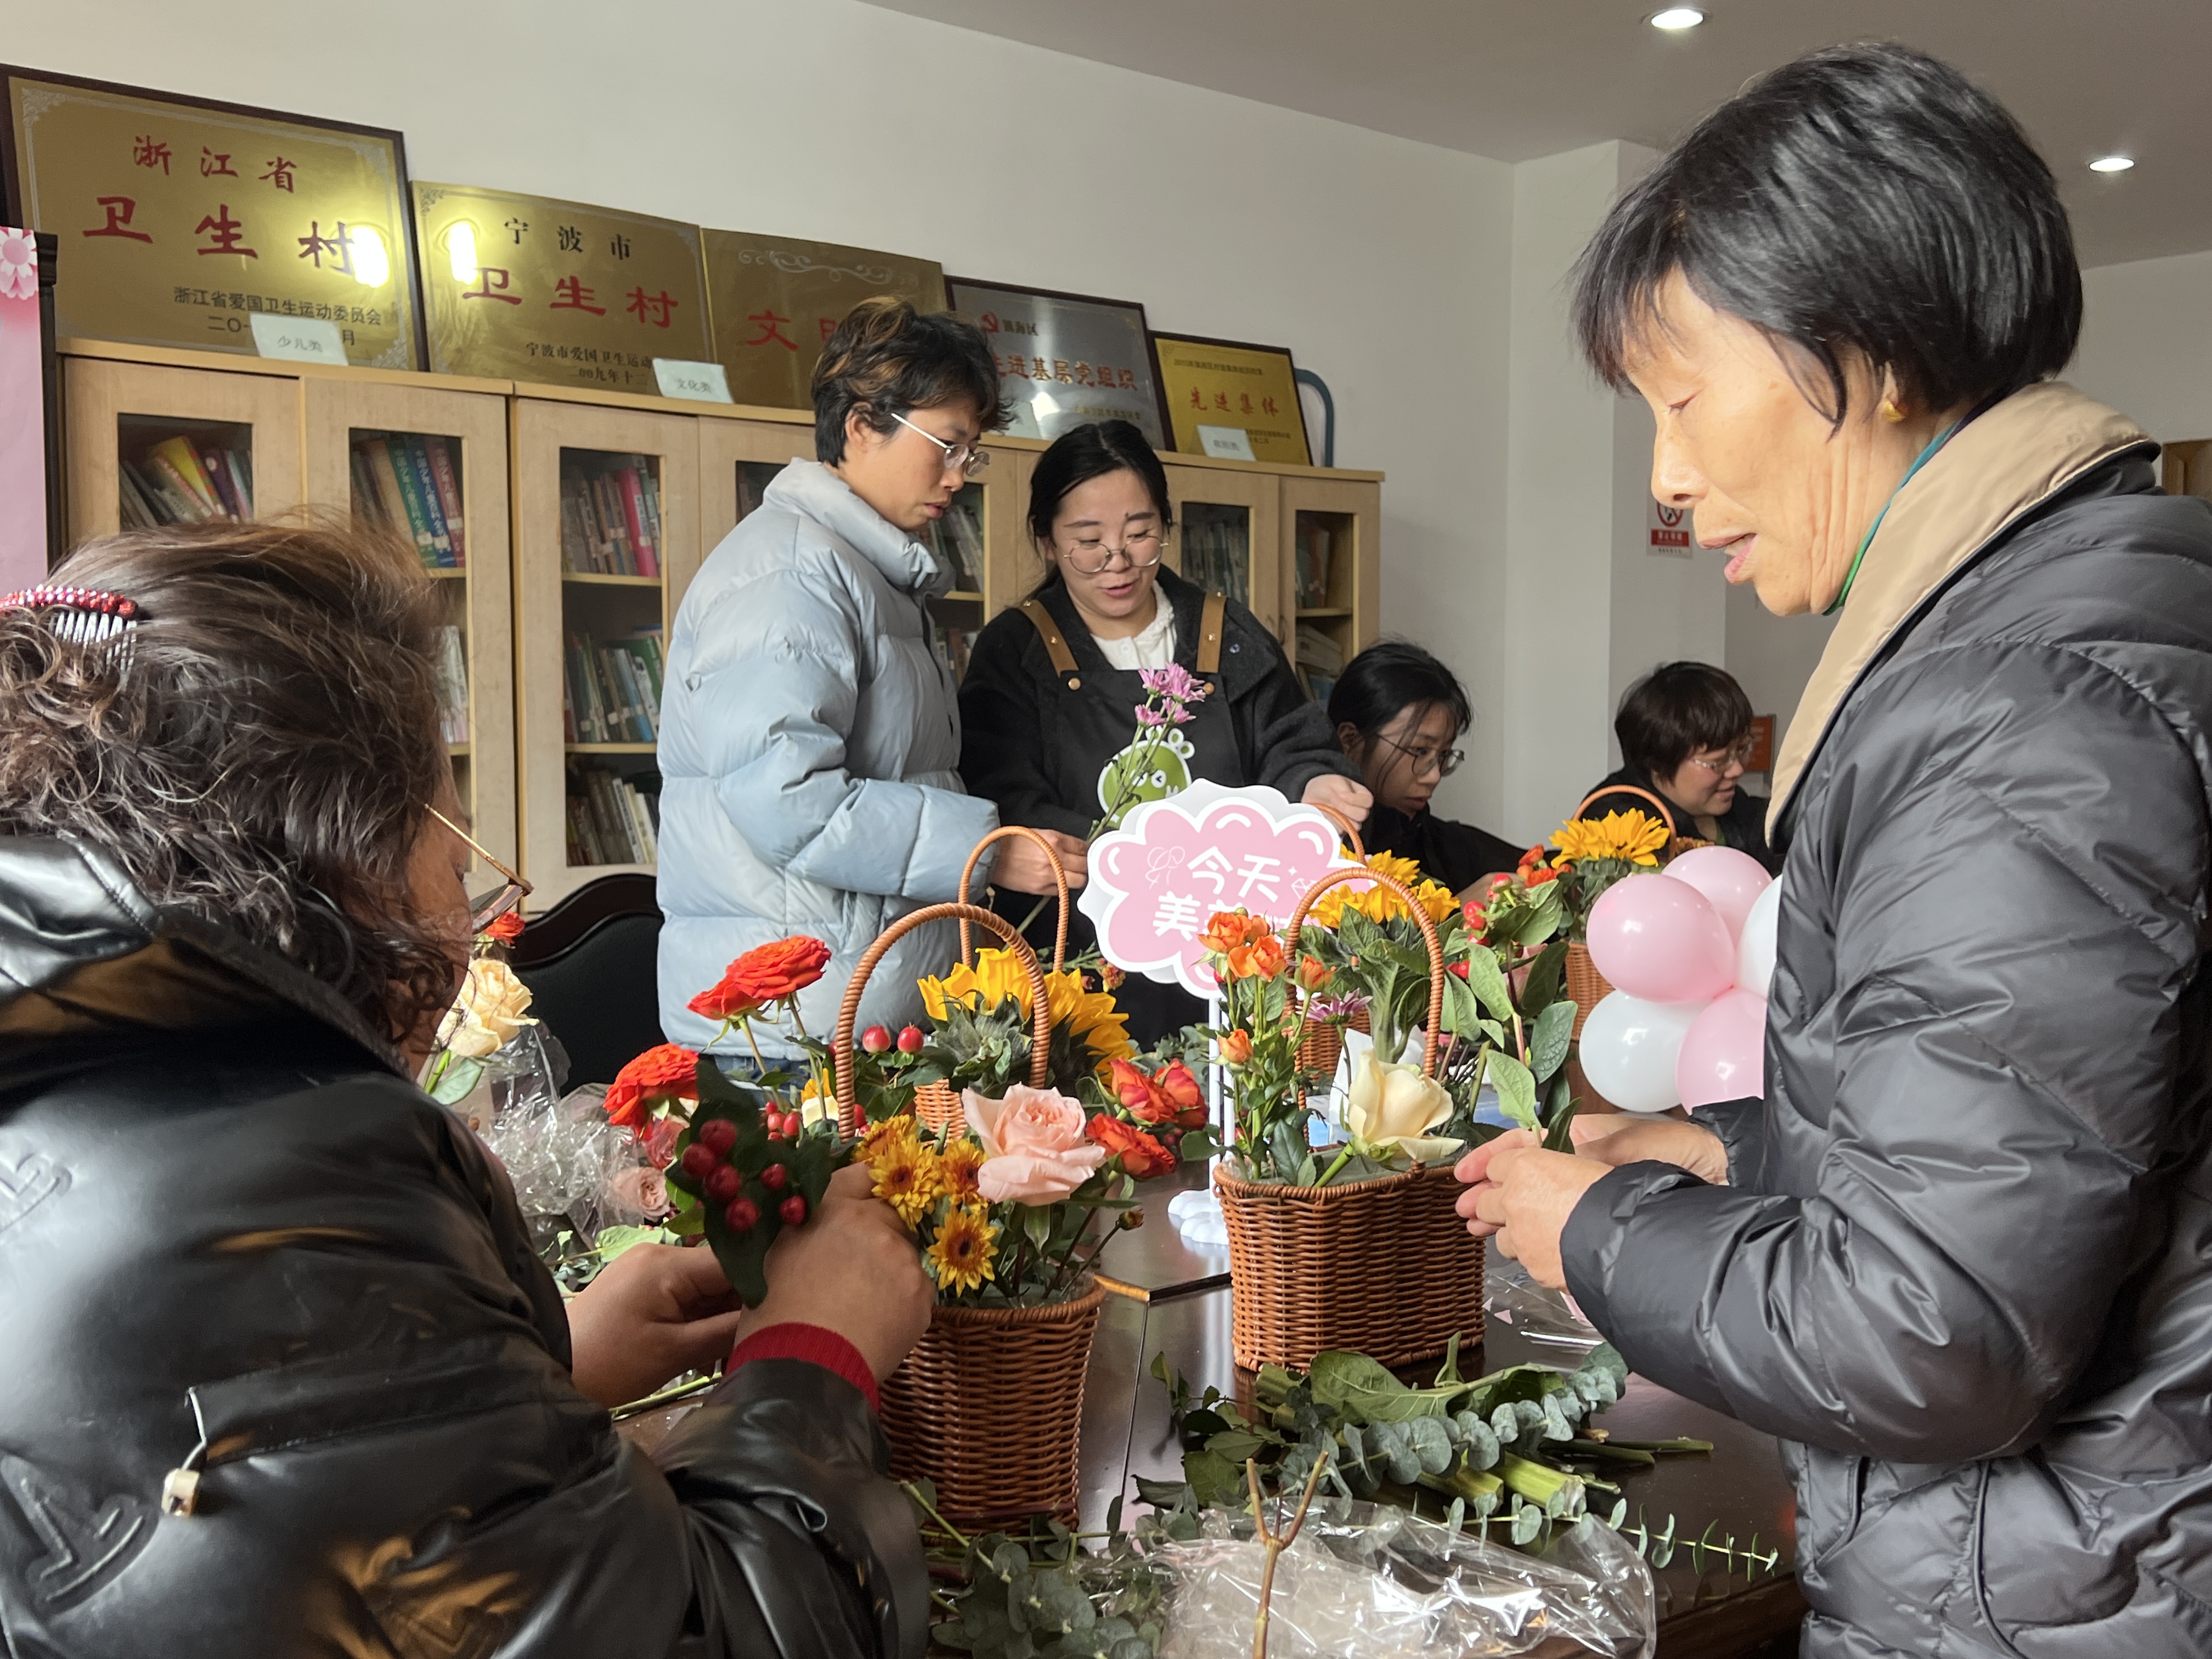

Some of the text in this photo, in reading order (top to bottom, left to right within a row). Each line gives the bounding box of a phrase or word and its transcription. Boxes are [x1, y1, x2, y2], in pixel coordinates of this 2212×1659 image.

[133, 135, 297, 194] 浙江省
[82, 195, 357, 275] 卫生村
[504, 217, 633, 261] 宁波市
[173, 285, 382, 326] 浙江省爱国卫生运动委员会
[462, 267, 679, 329] 卫生村
[1186, 845, 1282, 904] 今天
